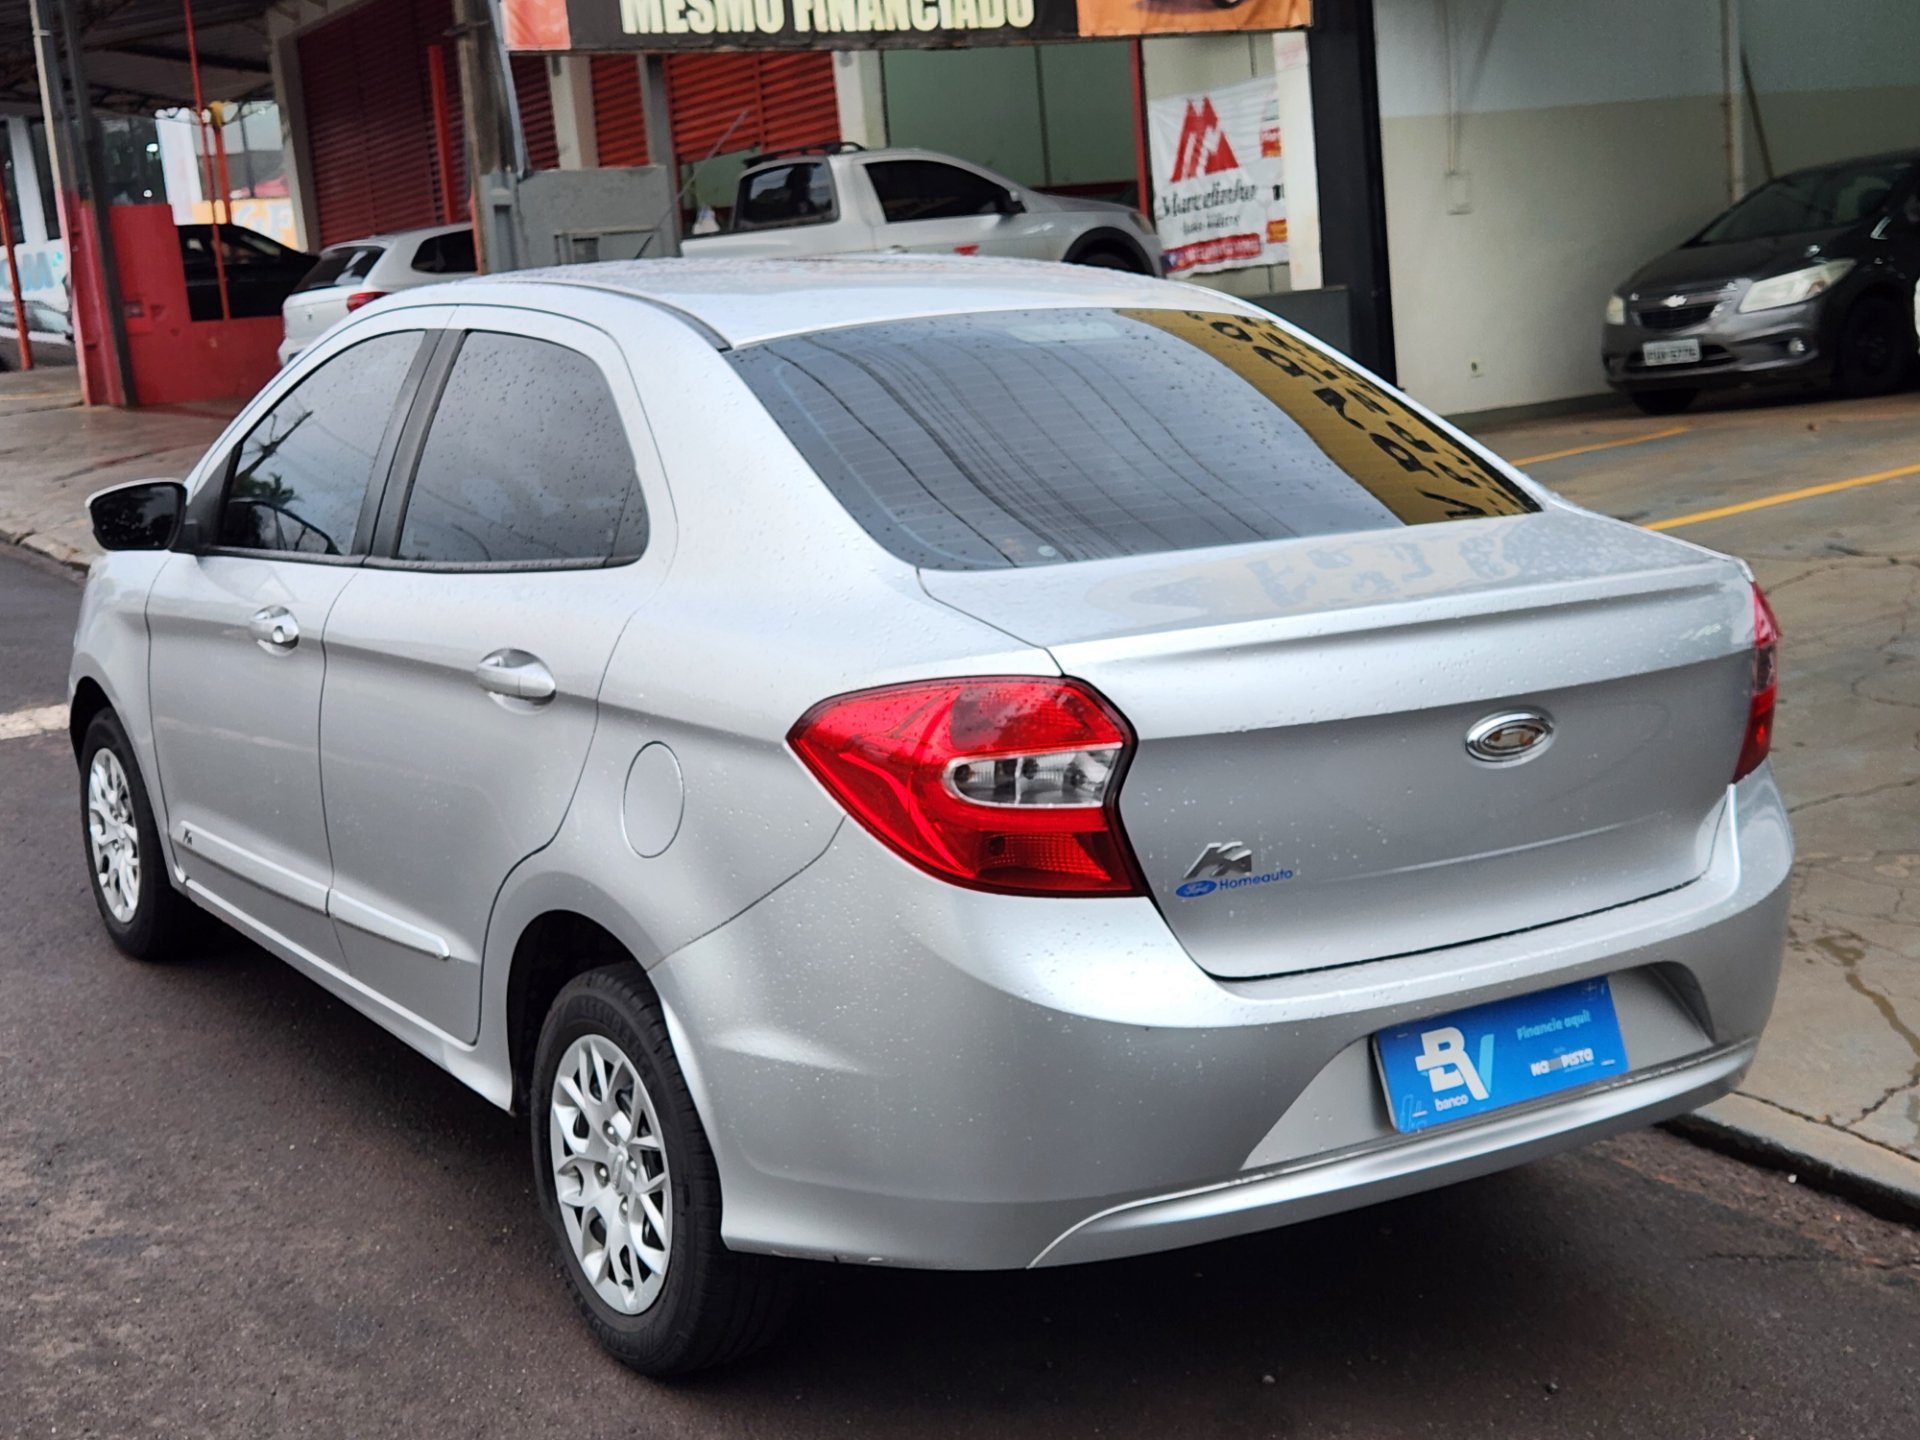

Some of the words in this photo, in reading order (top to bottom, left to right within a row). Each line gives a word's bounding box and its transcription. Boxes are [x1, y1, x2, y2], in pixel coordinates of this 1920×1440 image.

[619, 0, 785, 34] MESMO
[792, 0, 1035, 33] FINANCIADO
[1219, 870, 1294, 890] Homeauto
[1516, 1017, 1563, 1040] Financia
[1434, 1094, 1469, 1112] banco
